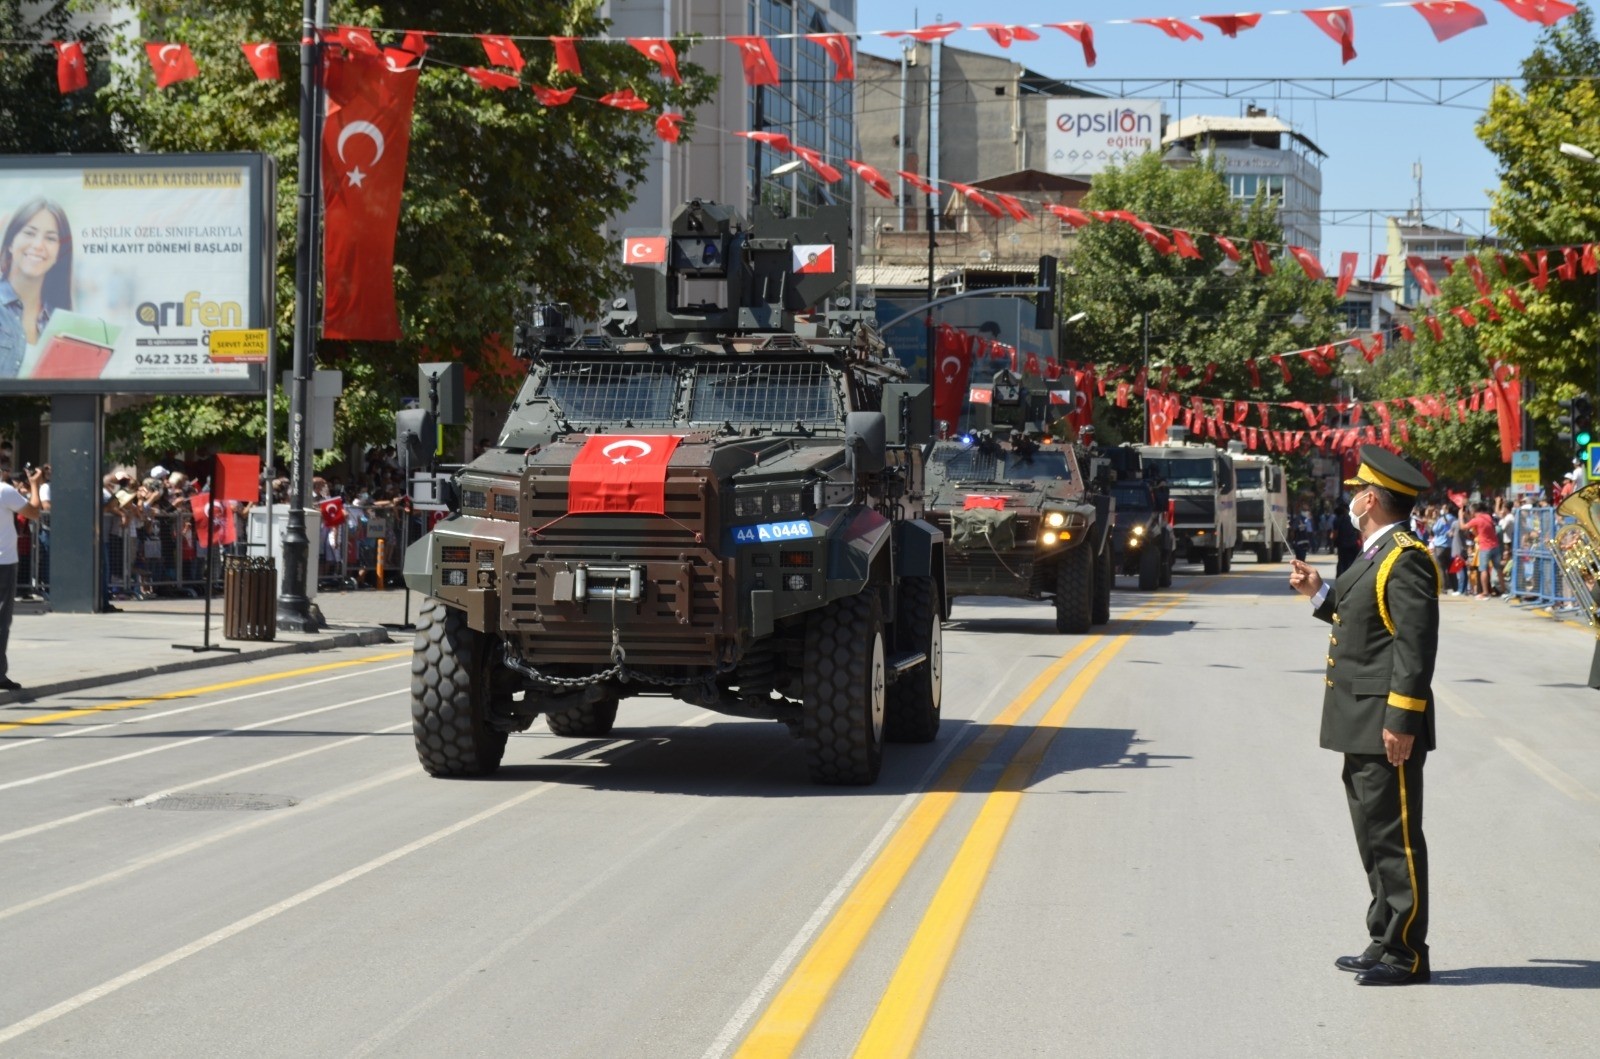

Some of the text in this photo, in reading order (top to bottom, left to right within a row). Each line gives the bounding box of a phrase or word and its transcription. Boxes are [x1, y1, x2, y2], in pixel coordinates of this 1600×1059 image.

[84, 171, 241, 186] KALABALIKTA KAYBOLMAYIN
[81, 225, 243, 240] 6 KİŞİLİK ÖZEL SINIFLARIYLA
[82, 241, 242, 255] YENİ KAYIT DÖNEMİ BAŞLADI
[244, 333, 264, 341] ŞEHİT
[243, 341, 264, 349] AKTAŞ
[135, 354, 170, 365] 0422
[174, 354, 198, 365] 325
[737, 523, 809, 541] 44 A 0446
